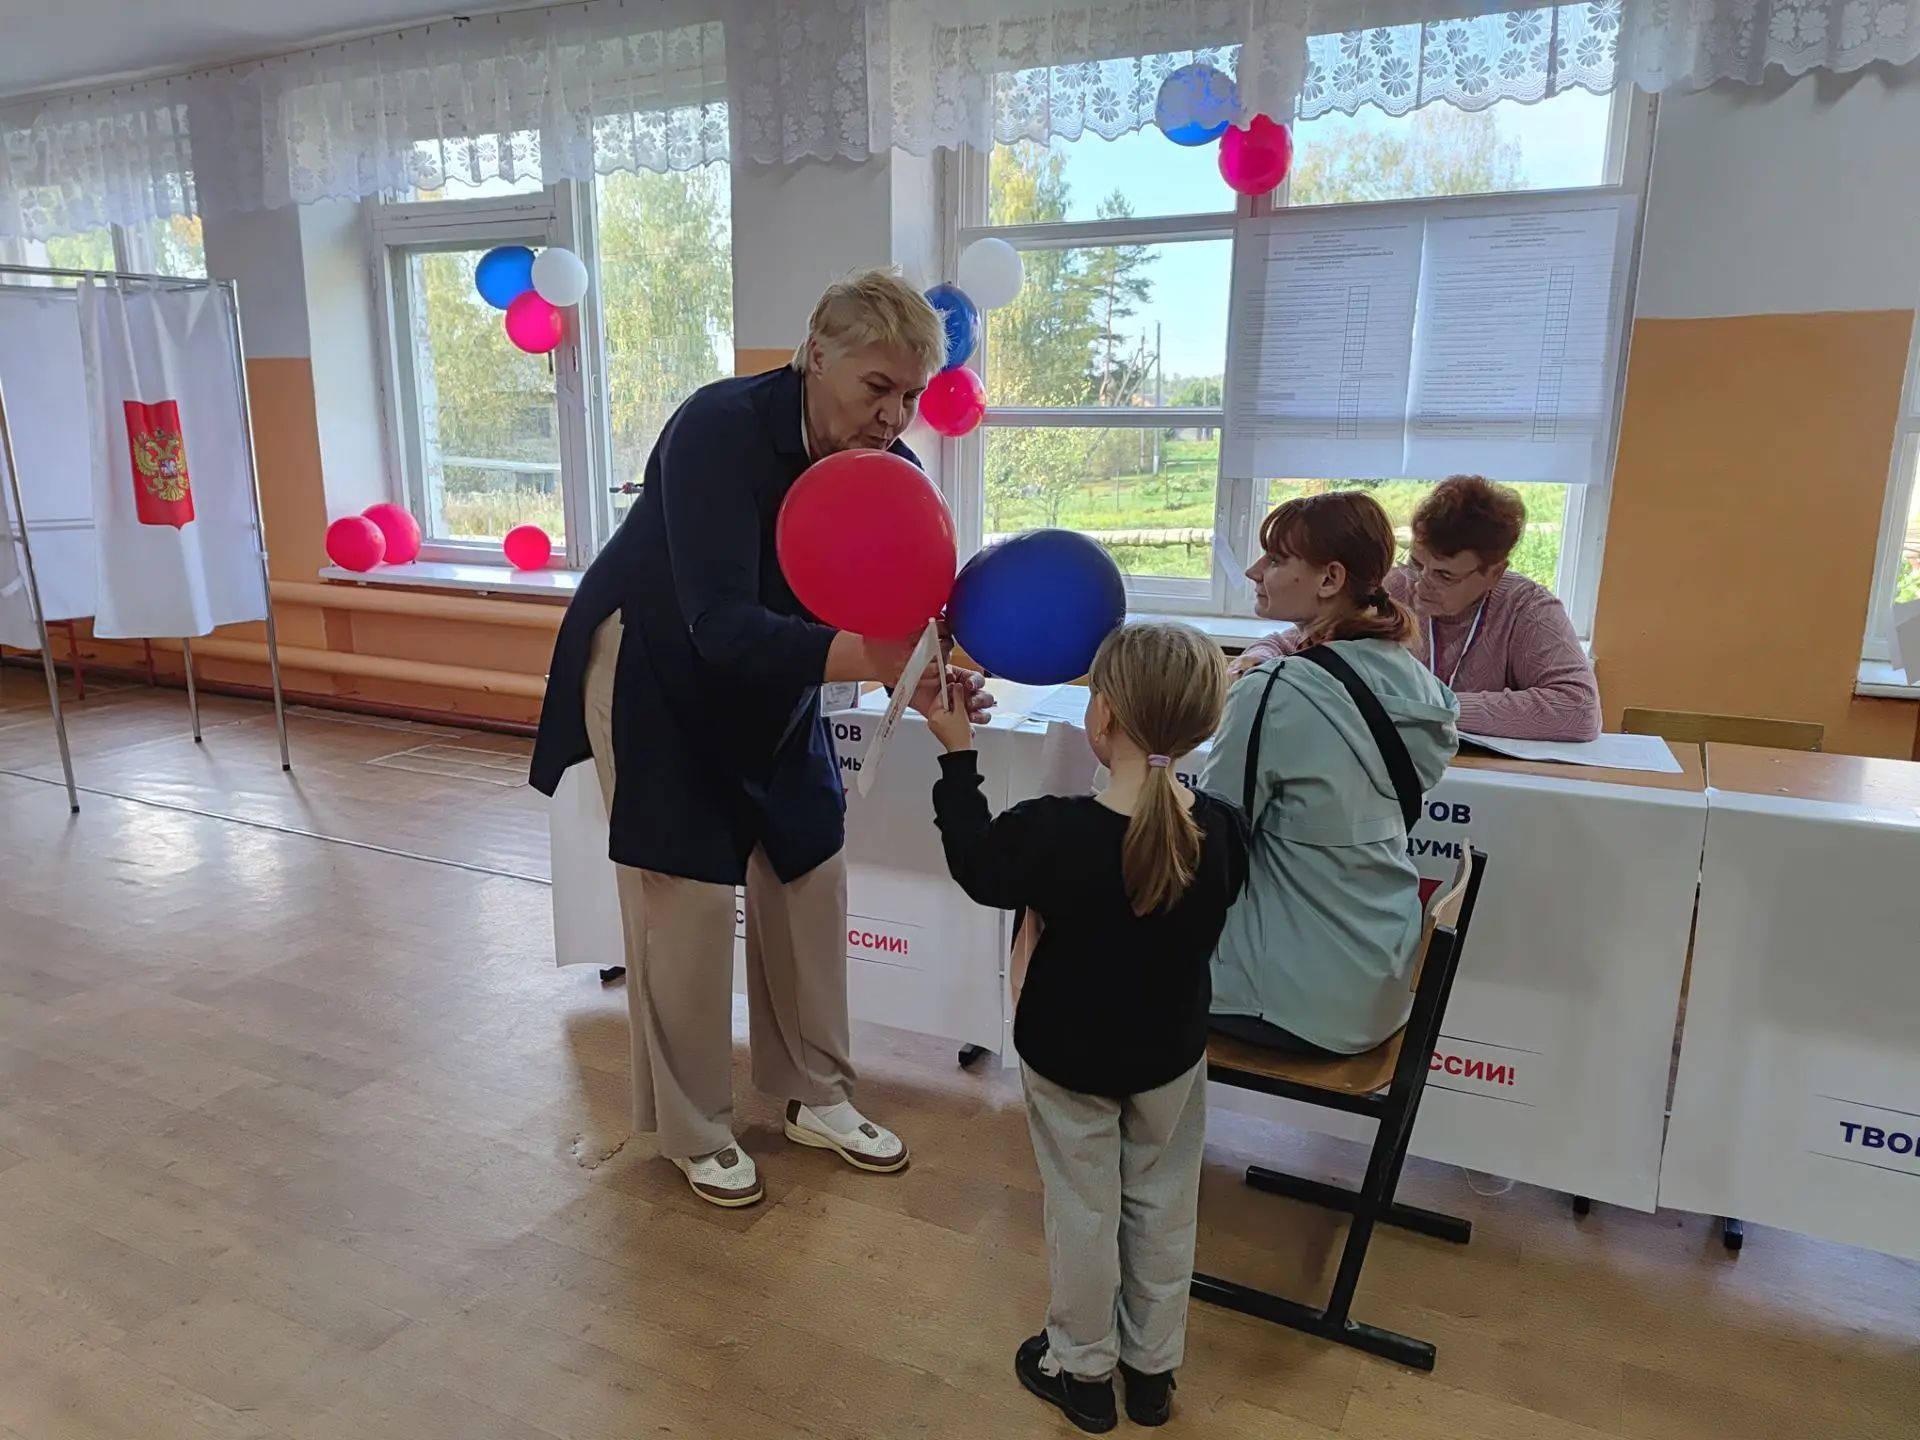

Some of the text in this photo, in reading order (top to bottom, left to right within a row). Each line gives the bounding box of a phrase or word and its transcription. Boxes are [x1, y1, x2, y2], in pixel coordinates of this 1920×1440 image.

[832, 723, 862, 742] ОВ
[1424, 801, 1471, 824] ОВ
[848, 930, 908, 954] ССИИ!
